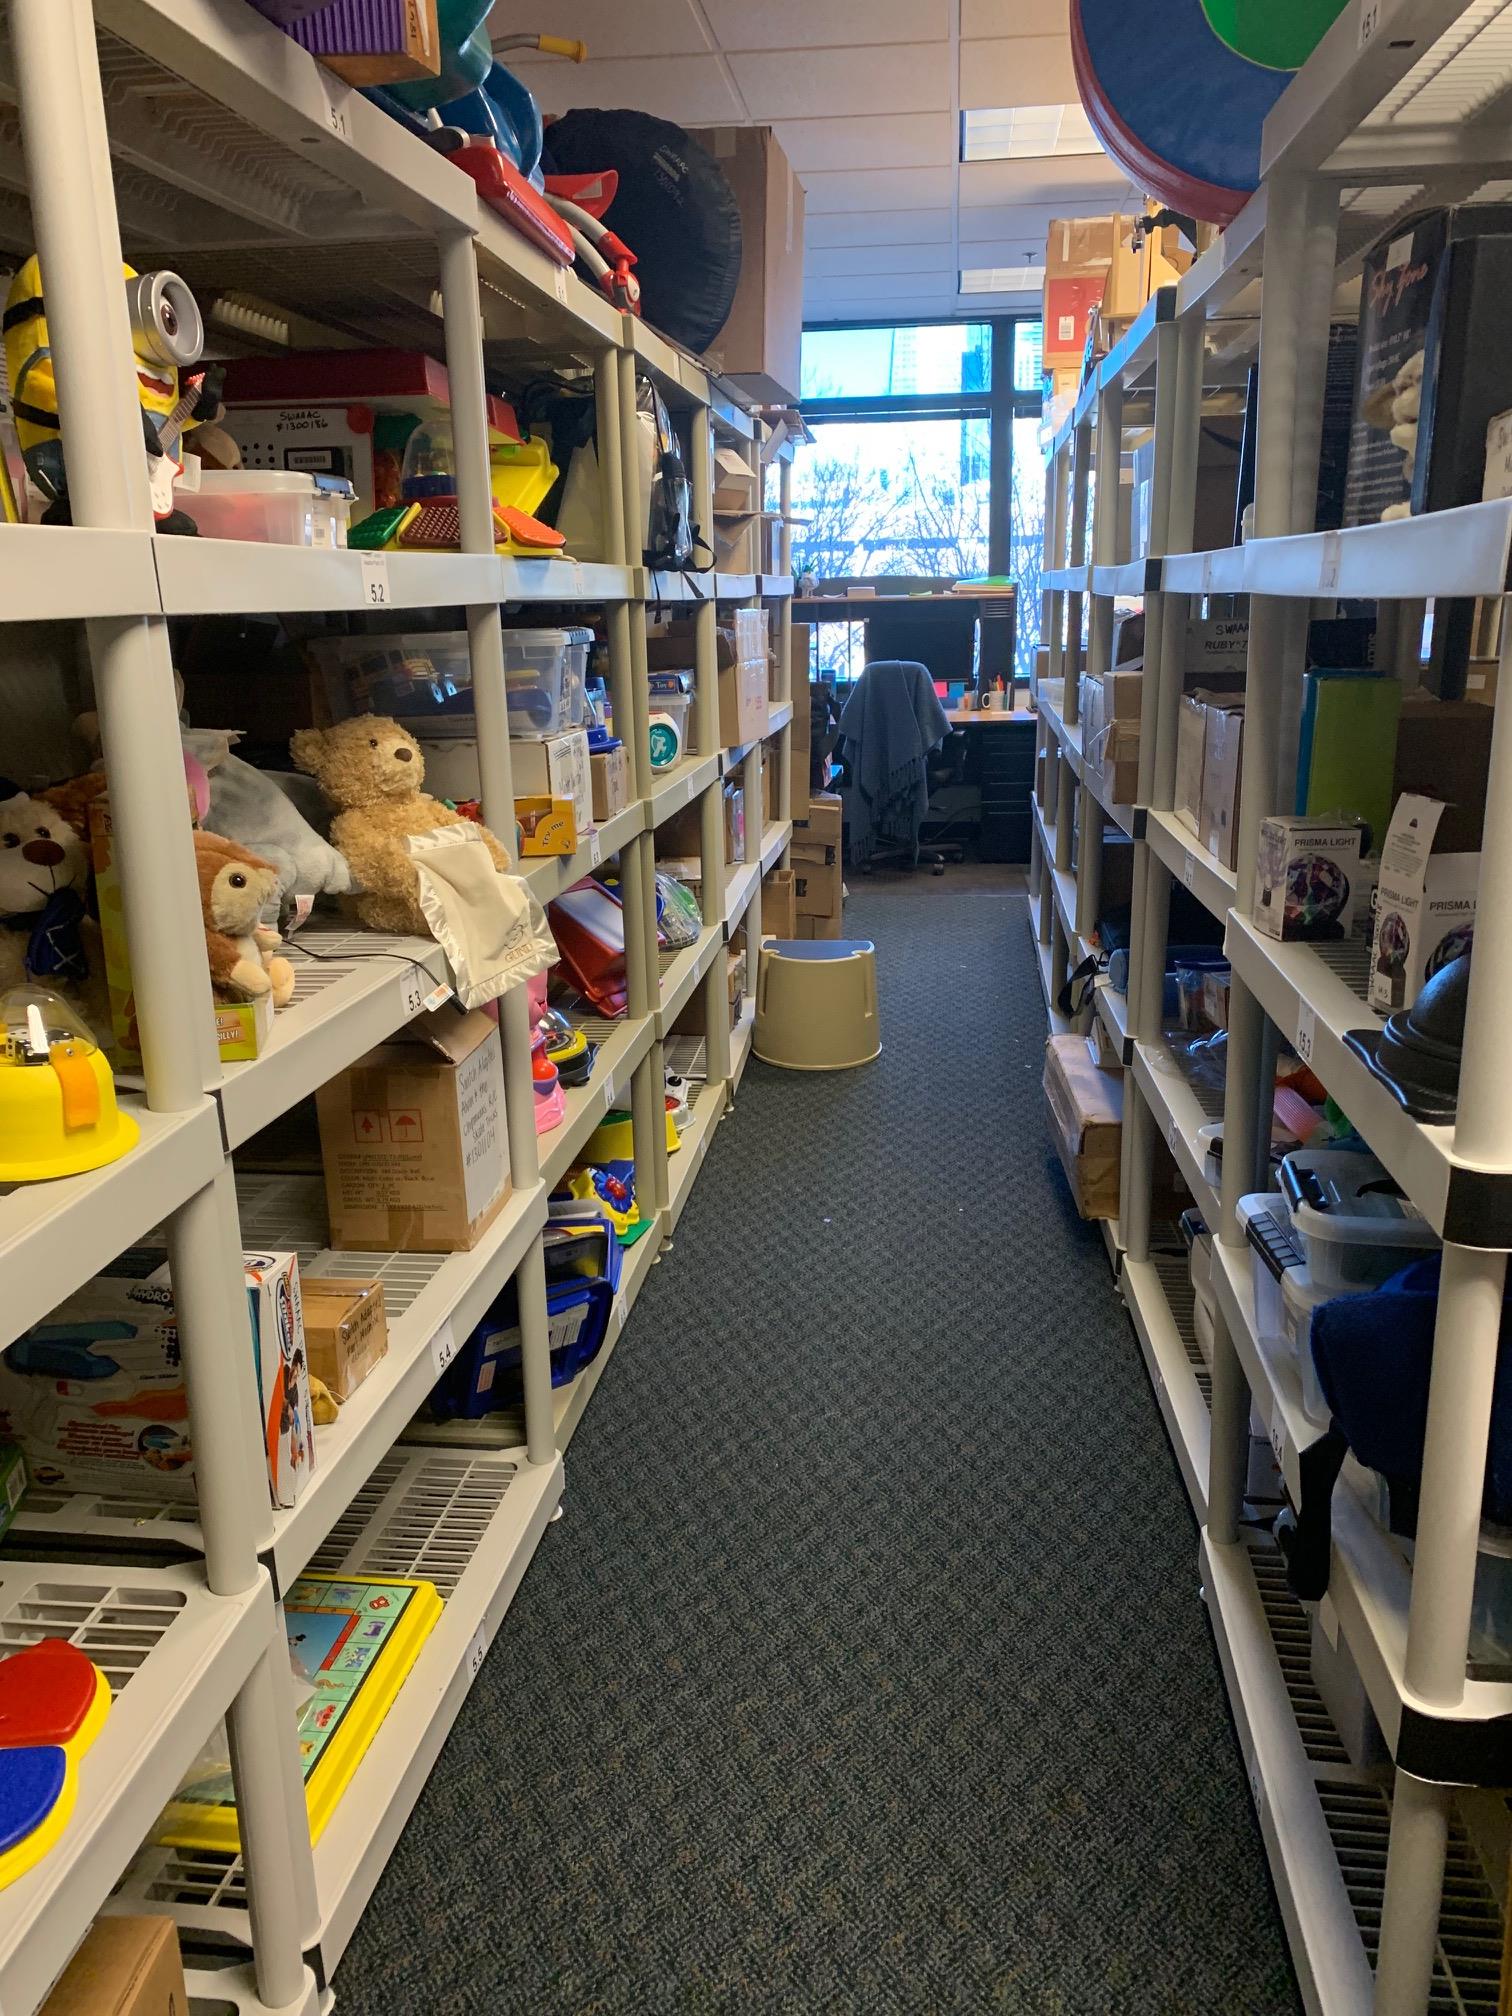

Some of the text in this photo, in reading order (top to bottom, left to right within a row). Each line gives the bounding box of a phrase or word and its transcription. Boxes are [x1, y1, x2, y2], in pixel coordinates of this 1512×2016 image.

[330, 106, 347, 136] 5.1
[370, 583, 385, 602] 5.2
[542, 820, 565, 847] Try me
[1294, 836, 1358, 848] PRISMA LIGHT
[1380, 886, 1401, 902] PRISMA
[1400, 894, 1420, 909] LIGHT
[1428, 899, 1471, 912] PRISMA
[408, 989, 422, 1012] 5.3
[132, 1288, 171, 1302] HYDRO
[439, 1344, 452, 1369] 5.4
[472, 1645, 483, 1673] 5.5
